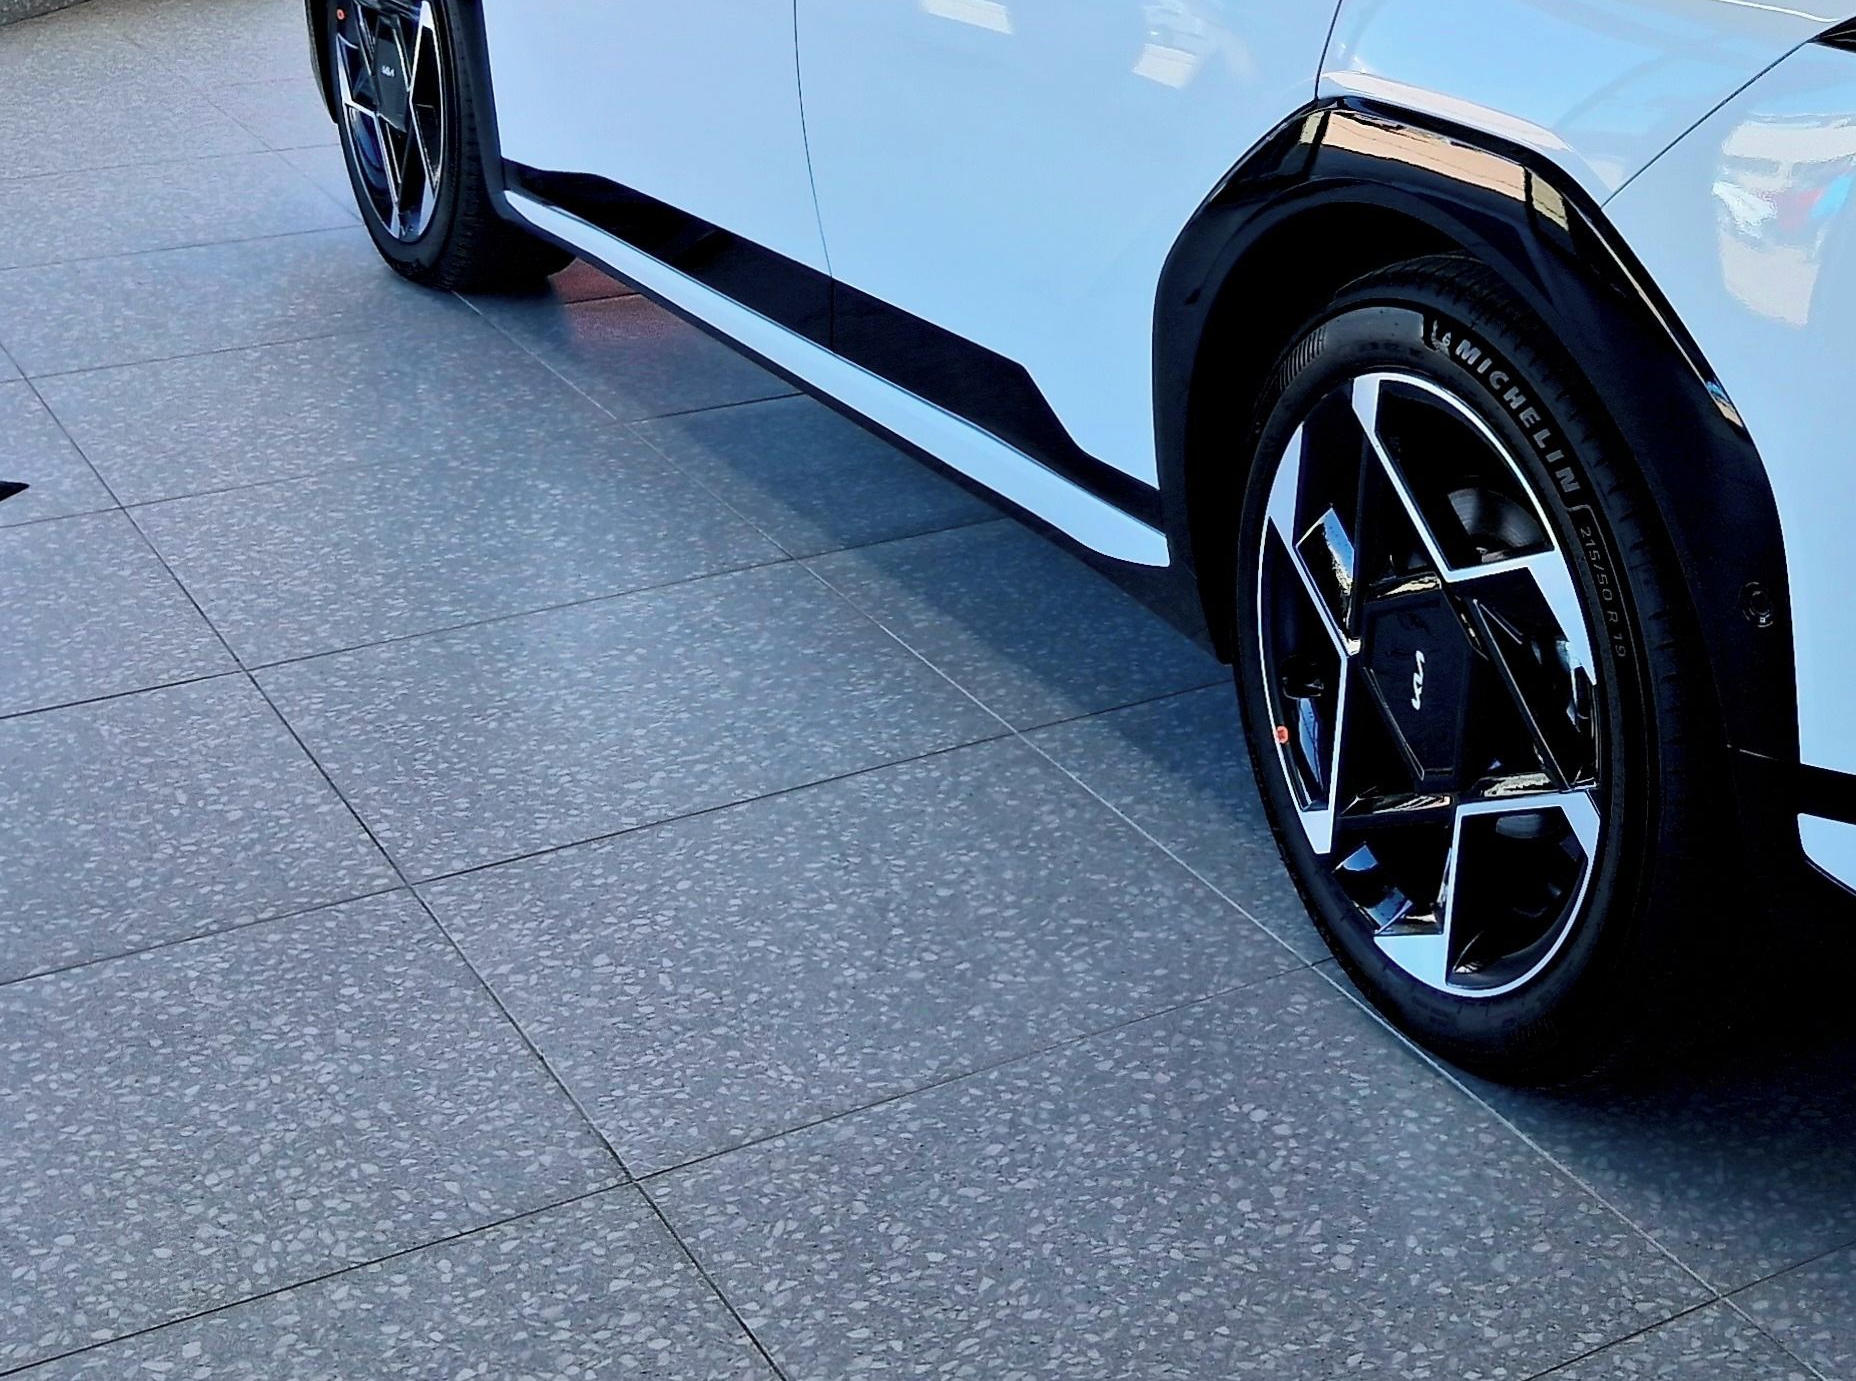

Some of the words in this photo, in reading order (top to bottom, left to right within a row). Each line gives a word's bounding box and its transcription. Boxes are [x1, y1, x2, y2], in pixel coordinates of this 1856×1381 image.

[1454, 338, 1581, 494] MICHELIN
[1580, 526, 1613, 602] 215/50
[1606, 610, 1619, 623] R
[1613, 634, 1626, 658] 19
[1410, 649, 1426, 711] KIA
